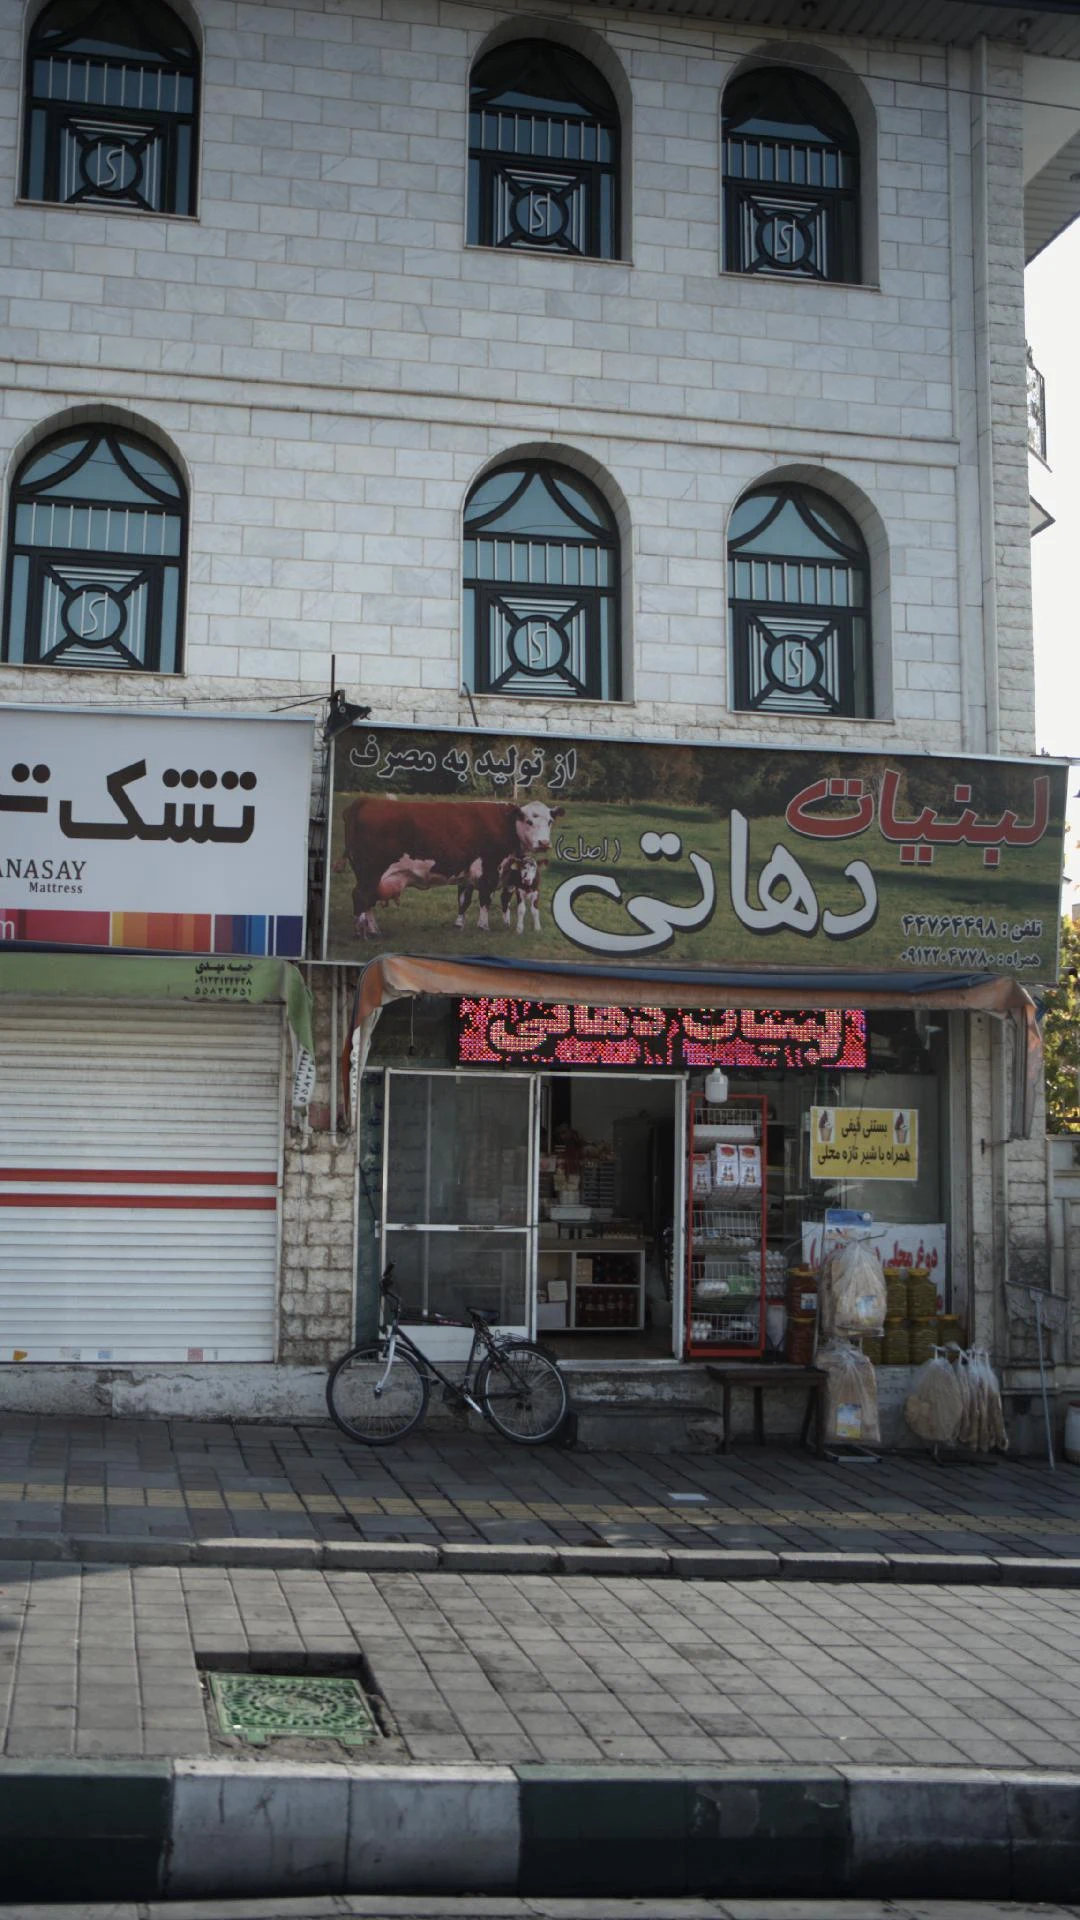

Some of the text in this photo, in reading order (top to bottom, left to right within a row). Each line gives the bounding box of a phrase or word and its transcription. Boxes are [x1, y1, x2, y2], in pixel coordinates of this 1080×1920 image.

[350, 734, 577, 789] از تولید به مصرف
[59, 758, 258, 844] تشک
[786, 768, 1050, 866] لبنیات
[29, 881, 83, 894] Mattress
[552, 808, 879, 956] دهاتی
[862, 1119, 888, 1138] بستنی
[817, 1144, 841, 1165] محلی
[860, 1146, 877, 1165] شیر
[886, 1145, 911, 1166] همراه
